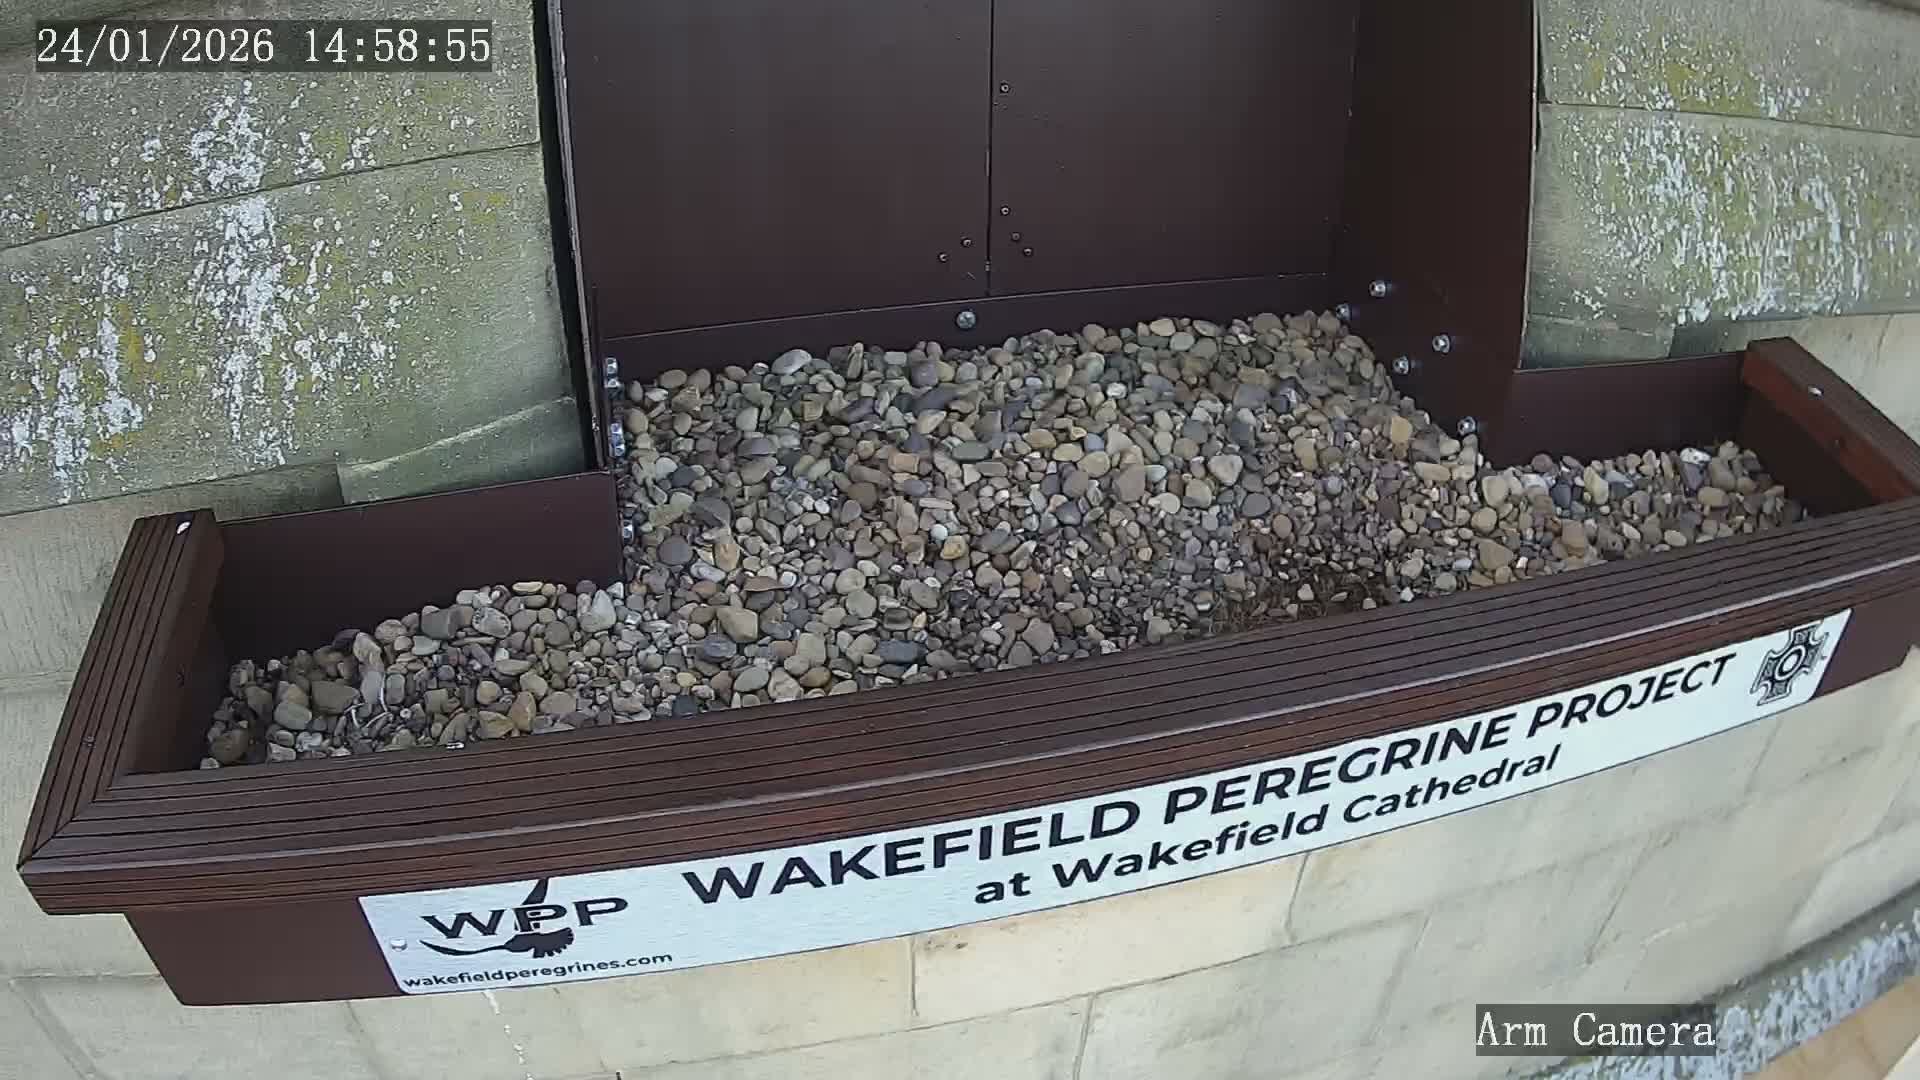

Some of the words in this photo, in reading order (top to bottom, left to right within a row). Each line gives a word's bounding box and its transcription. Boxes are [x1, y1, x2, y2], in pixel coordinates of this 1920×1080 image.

[682, 800, 1141, 904] WAKEFIELD
[1163, 713, 1517, 824] PEREGRINE
[1527, 653, 1736, 738] PROJECT
[975, 871, 1031, 904] at
[1052, 803, 1327, 888] Wakefield
[1343, 744, 1561, 824] Cathedral
[420, 897, 629, 940] WPP
[403, 952, 674, 988] wakefieldperegrines.com
